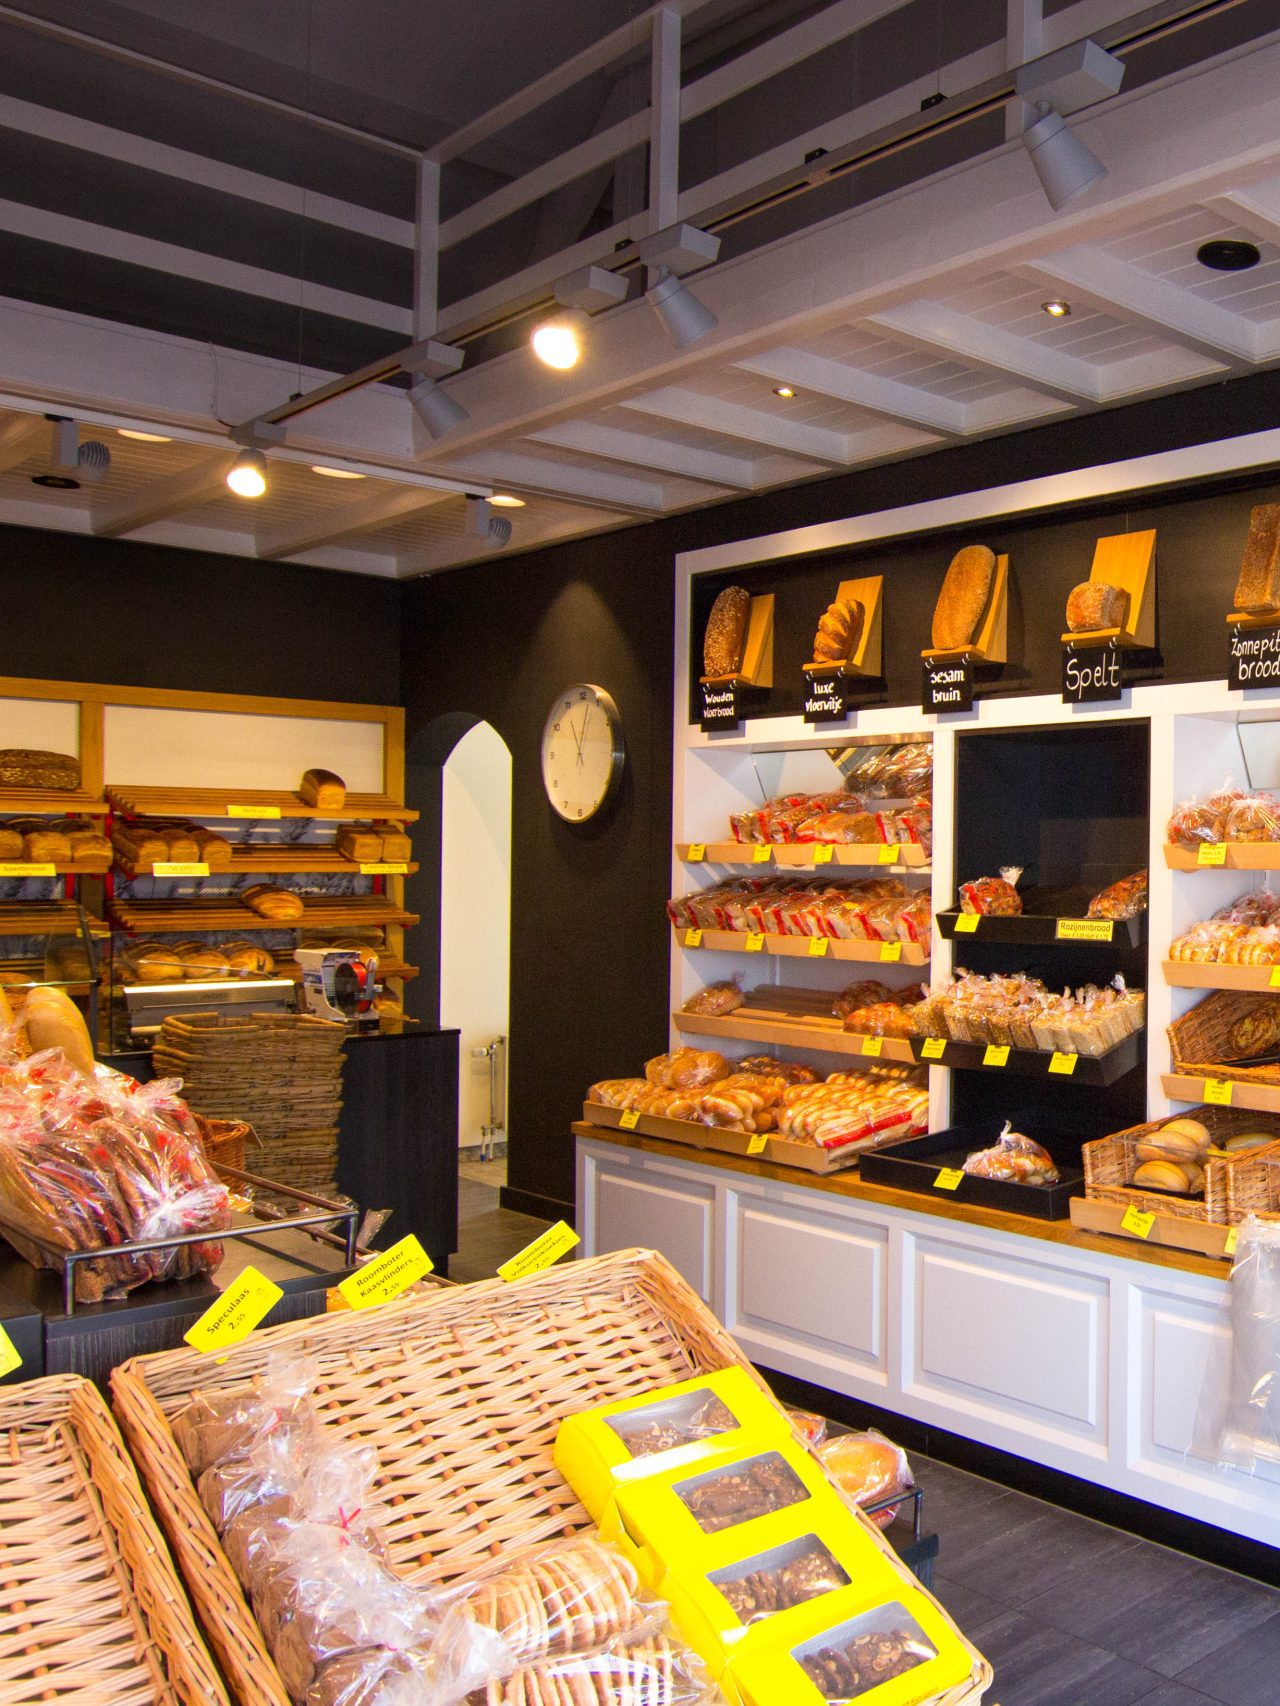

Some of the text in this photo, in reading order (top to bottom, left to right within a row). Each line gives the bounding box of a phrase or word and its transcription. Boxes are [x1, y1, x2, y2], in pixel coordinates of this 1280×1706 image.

[929, 669, 965, 684] sesam
[1066, 652, 1120, 699] Spelt
[1238, 655, 1280, 680] brood
[580, 692, 587, 701] 12
[814, 681, 835, 695] luxe
[932, 687, 962, 703] bruin
[1060, 922, 1111, 932] Rozijnenbrood
[356, 1251, 404, 1287] Roomboter
[359, 1258, 413, 1297] Kaasvlinders
[206, 1289, 250, 1334] Speculaas
